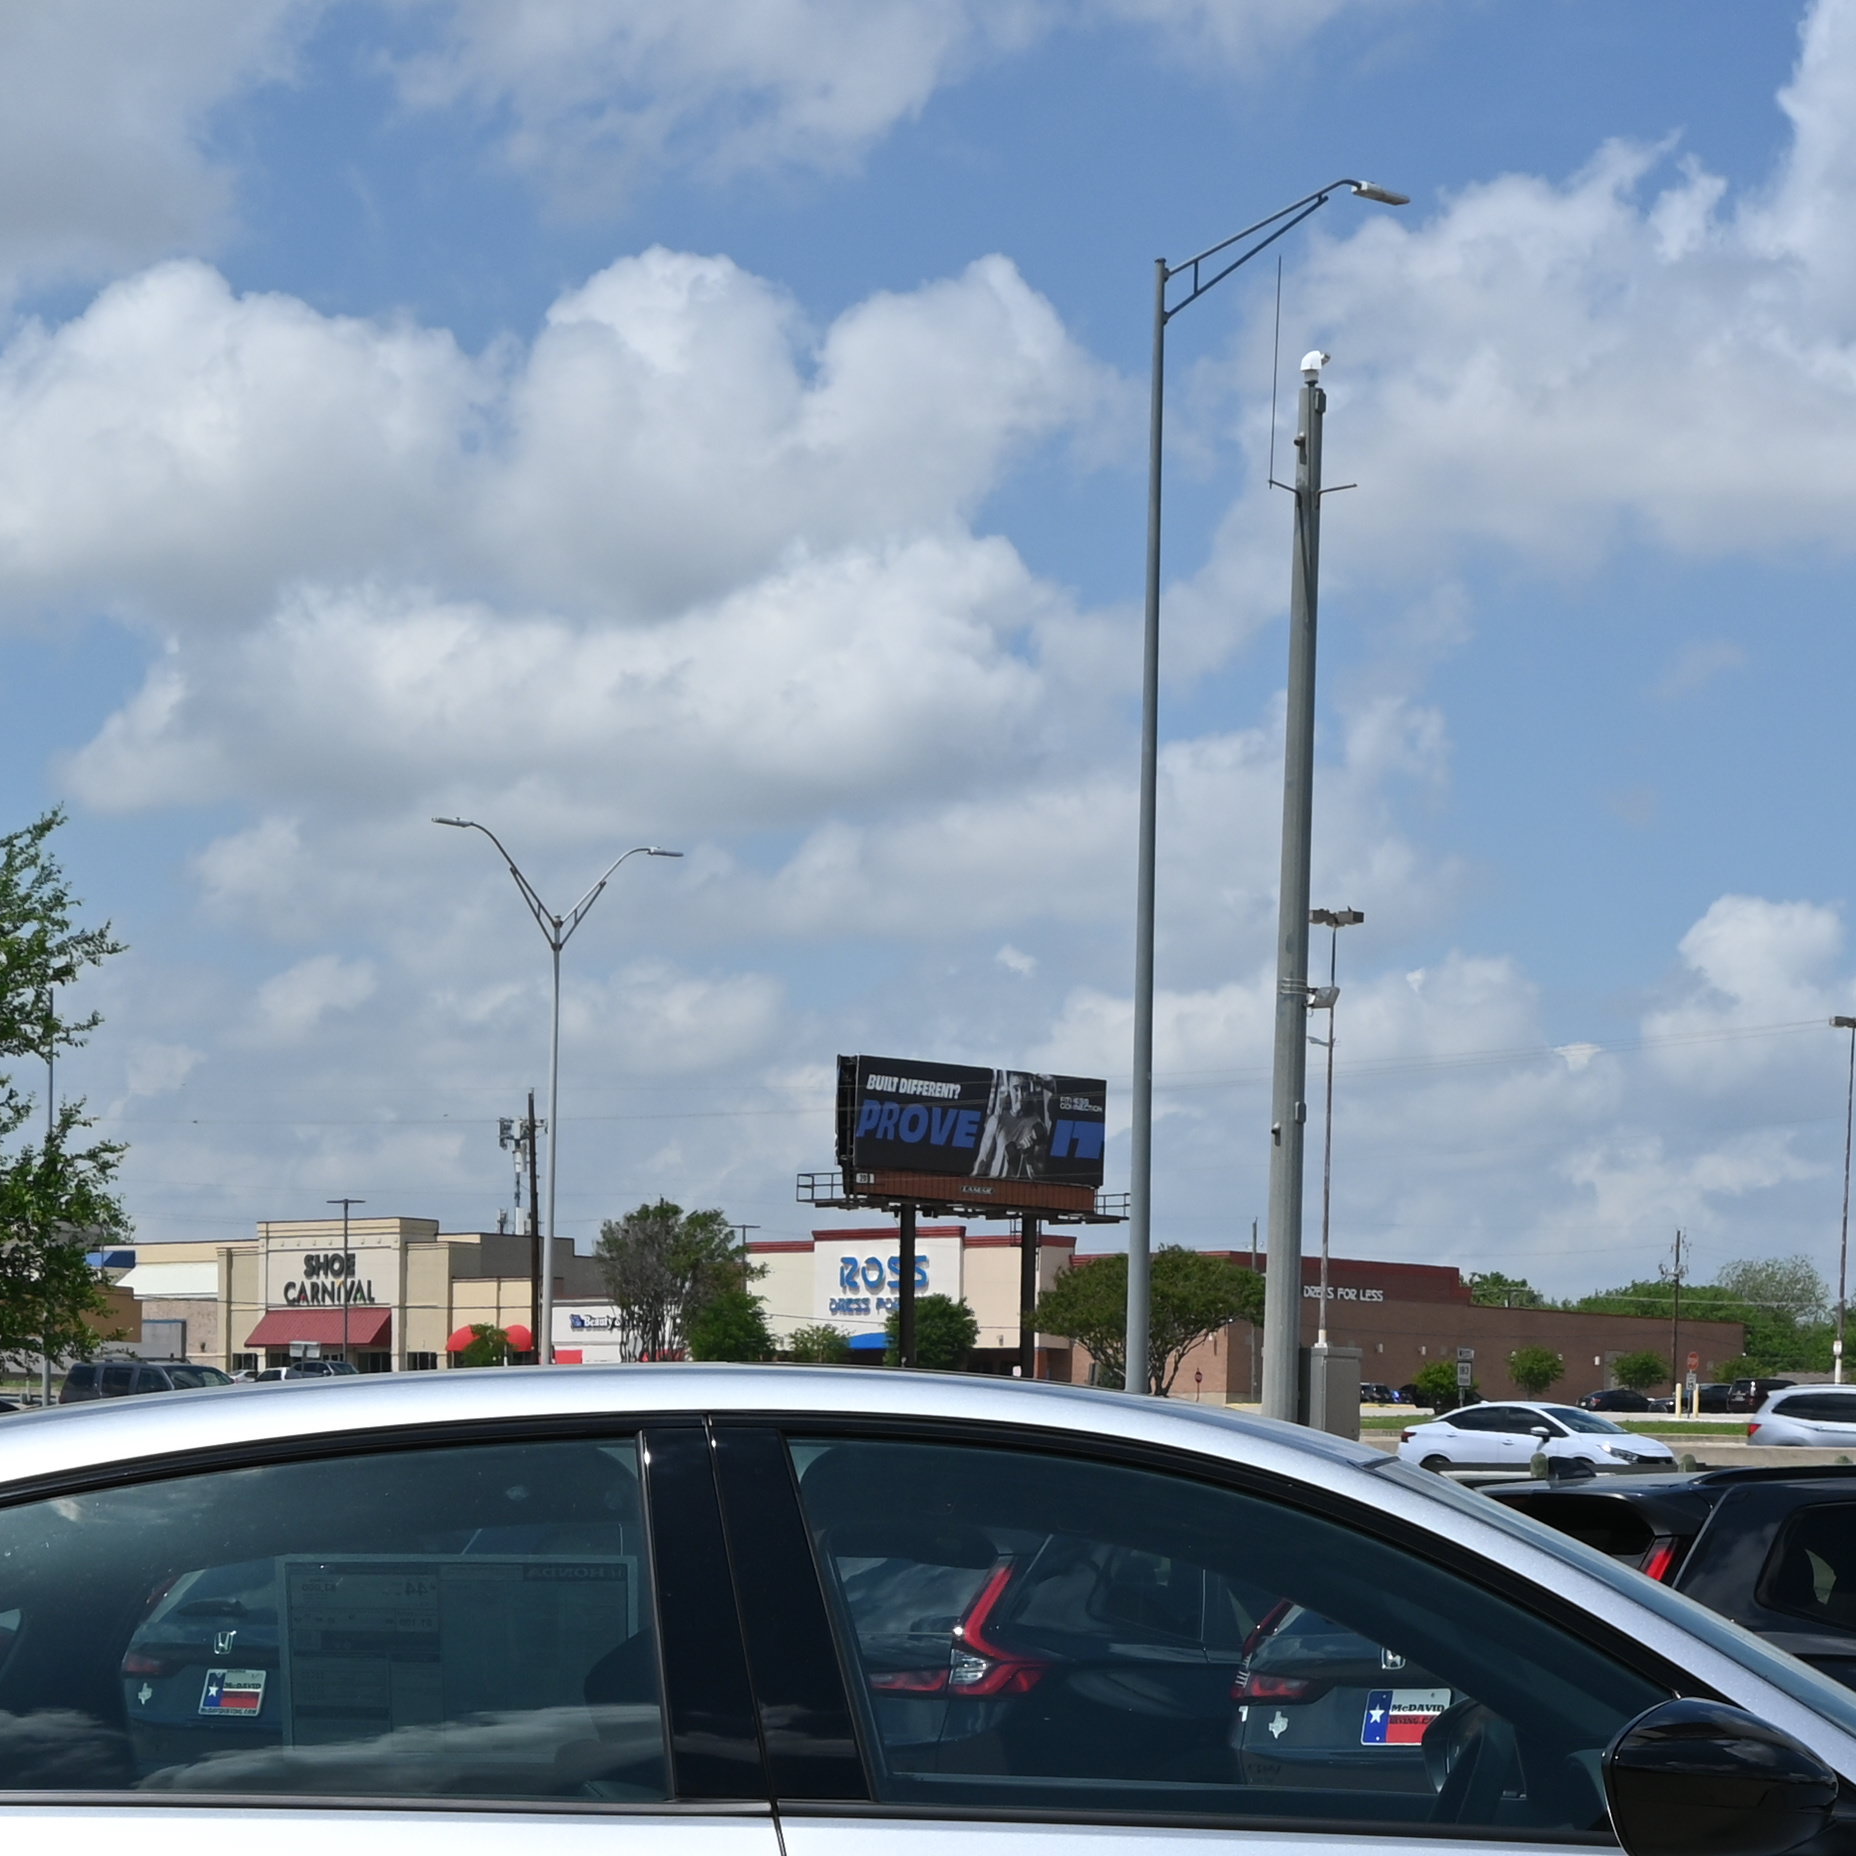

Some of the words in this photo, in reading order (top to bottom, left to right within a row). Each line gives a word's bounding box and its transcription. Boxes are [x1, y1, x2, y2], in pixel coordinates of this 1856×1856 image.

[866, 1074, 899, 1093] BUILT
[898, 1078, 962, 1099] DIFFERENT?
[855, 1099, 982, 1148] PROVE
[1050, 1119, 1105, 1160] IT
[304, 1253, 356, 1280] SHOE
[840, 1254, 929, 1290] ROSS
[284, 1279, 376, 1306] CARNIVAL
[1303, 1285, 1334, 1299] DRES
[1337, 1287, 1358, 1300] FOR
[1359, 1289, 1384, 1302] LESS
[1391, 1703, 1445, 1713] McDAVID
